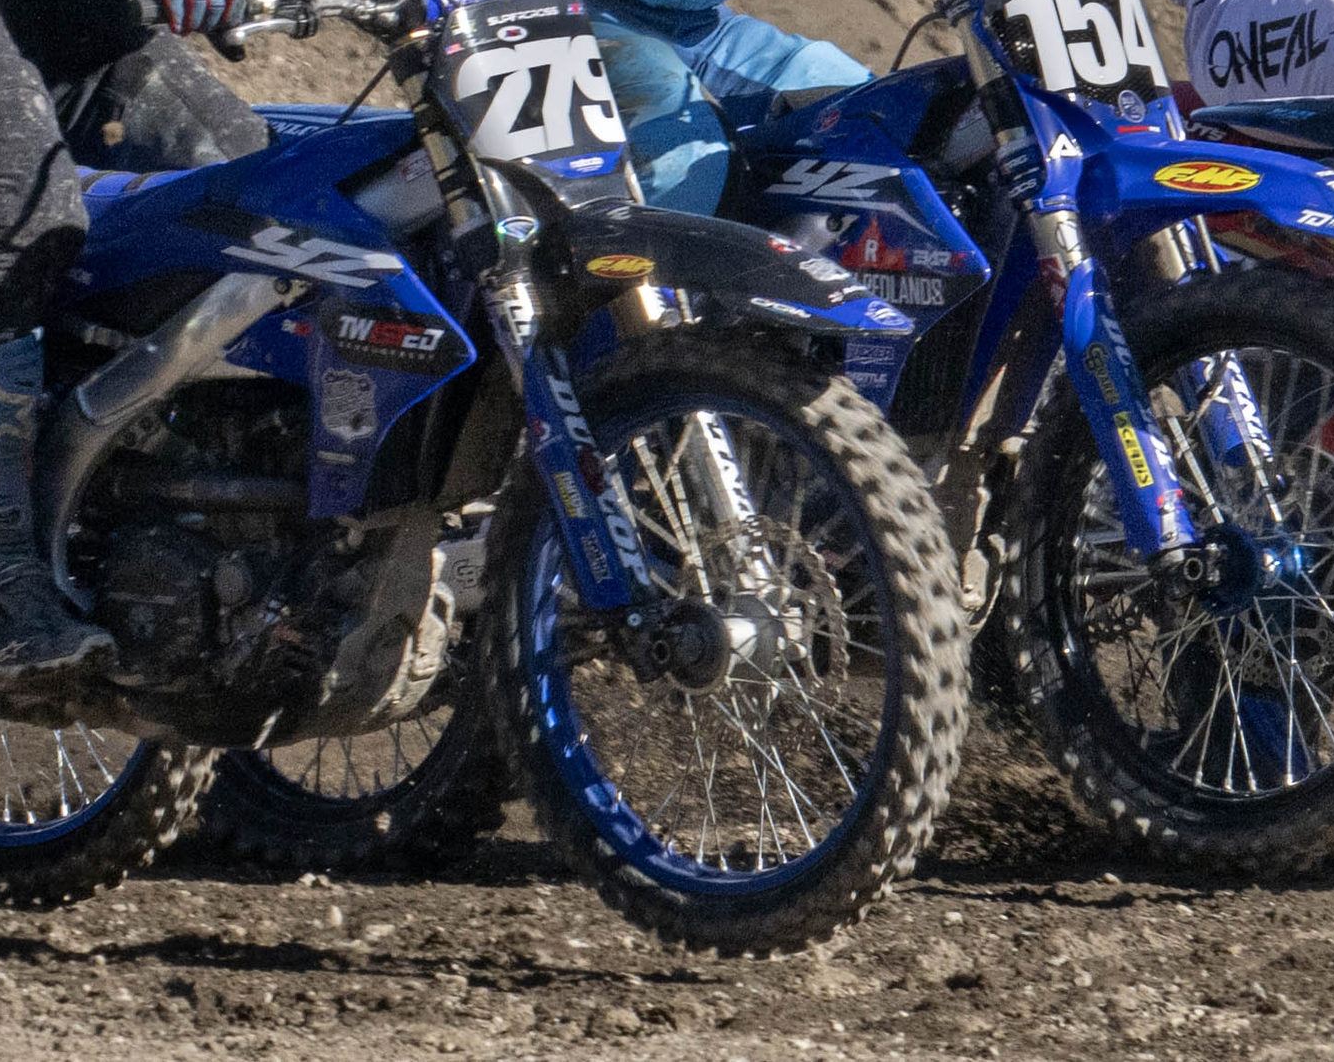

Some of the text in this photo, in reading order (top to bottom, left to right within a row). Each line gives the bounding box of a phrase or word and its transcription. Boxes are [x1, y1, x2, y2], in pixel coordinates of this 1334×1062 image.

[454, 35, 626, 160] 279
[1154, 163, 1261, 190] FMF
[547, 372, 652, 590] DULOP
